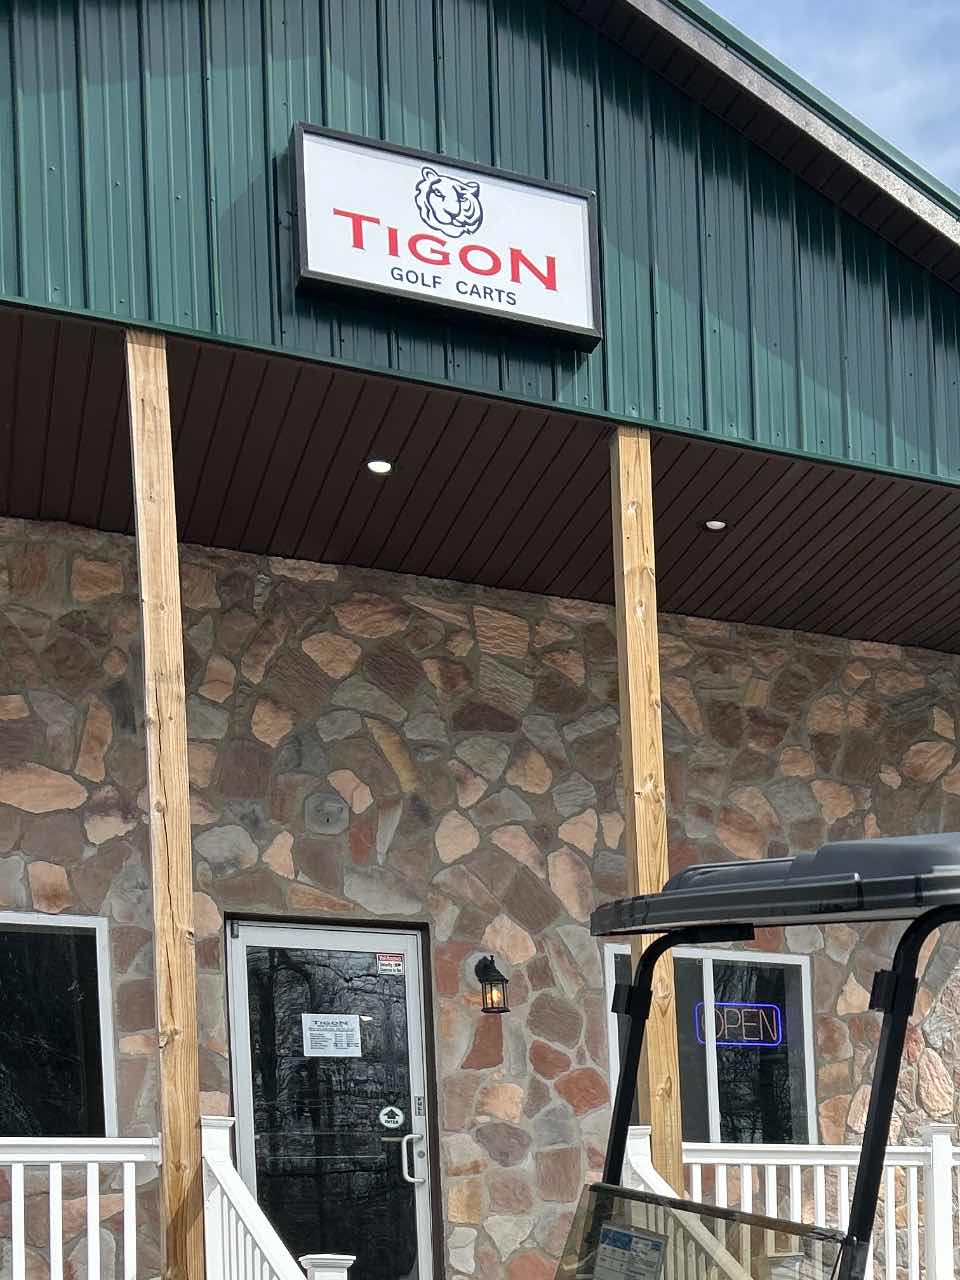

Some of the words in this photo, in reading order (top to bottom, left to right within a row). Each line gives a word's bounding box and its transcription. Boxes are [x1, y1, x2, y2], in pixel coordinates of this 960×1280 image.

[333, 207, 558, 292] TIGON
[390, 266, 442, 289] GOLF
[456, 281, 517, 306] CARTS
[701, 1008, 777, 1041] OPEN
